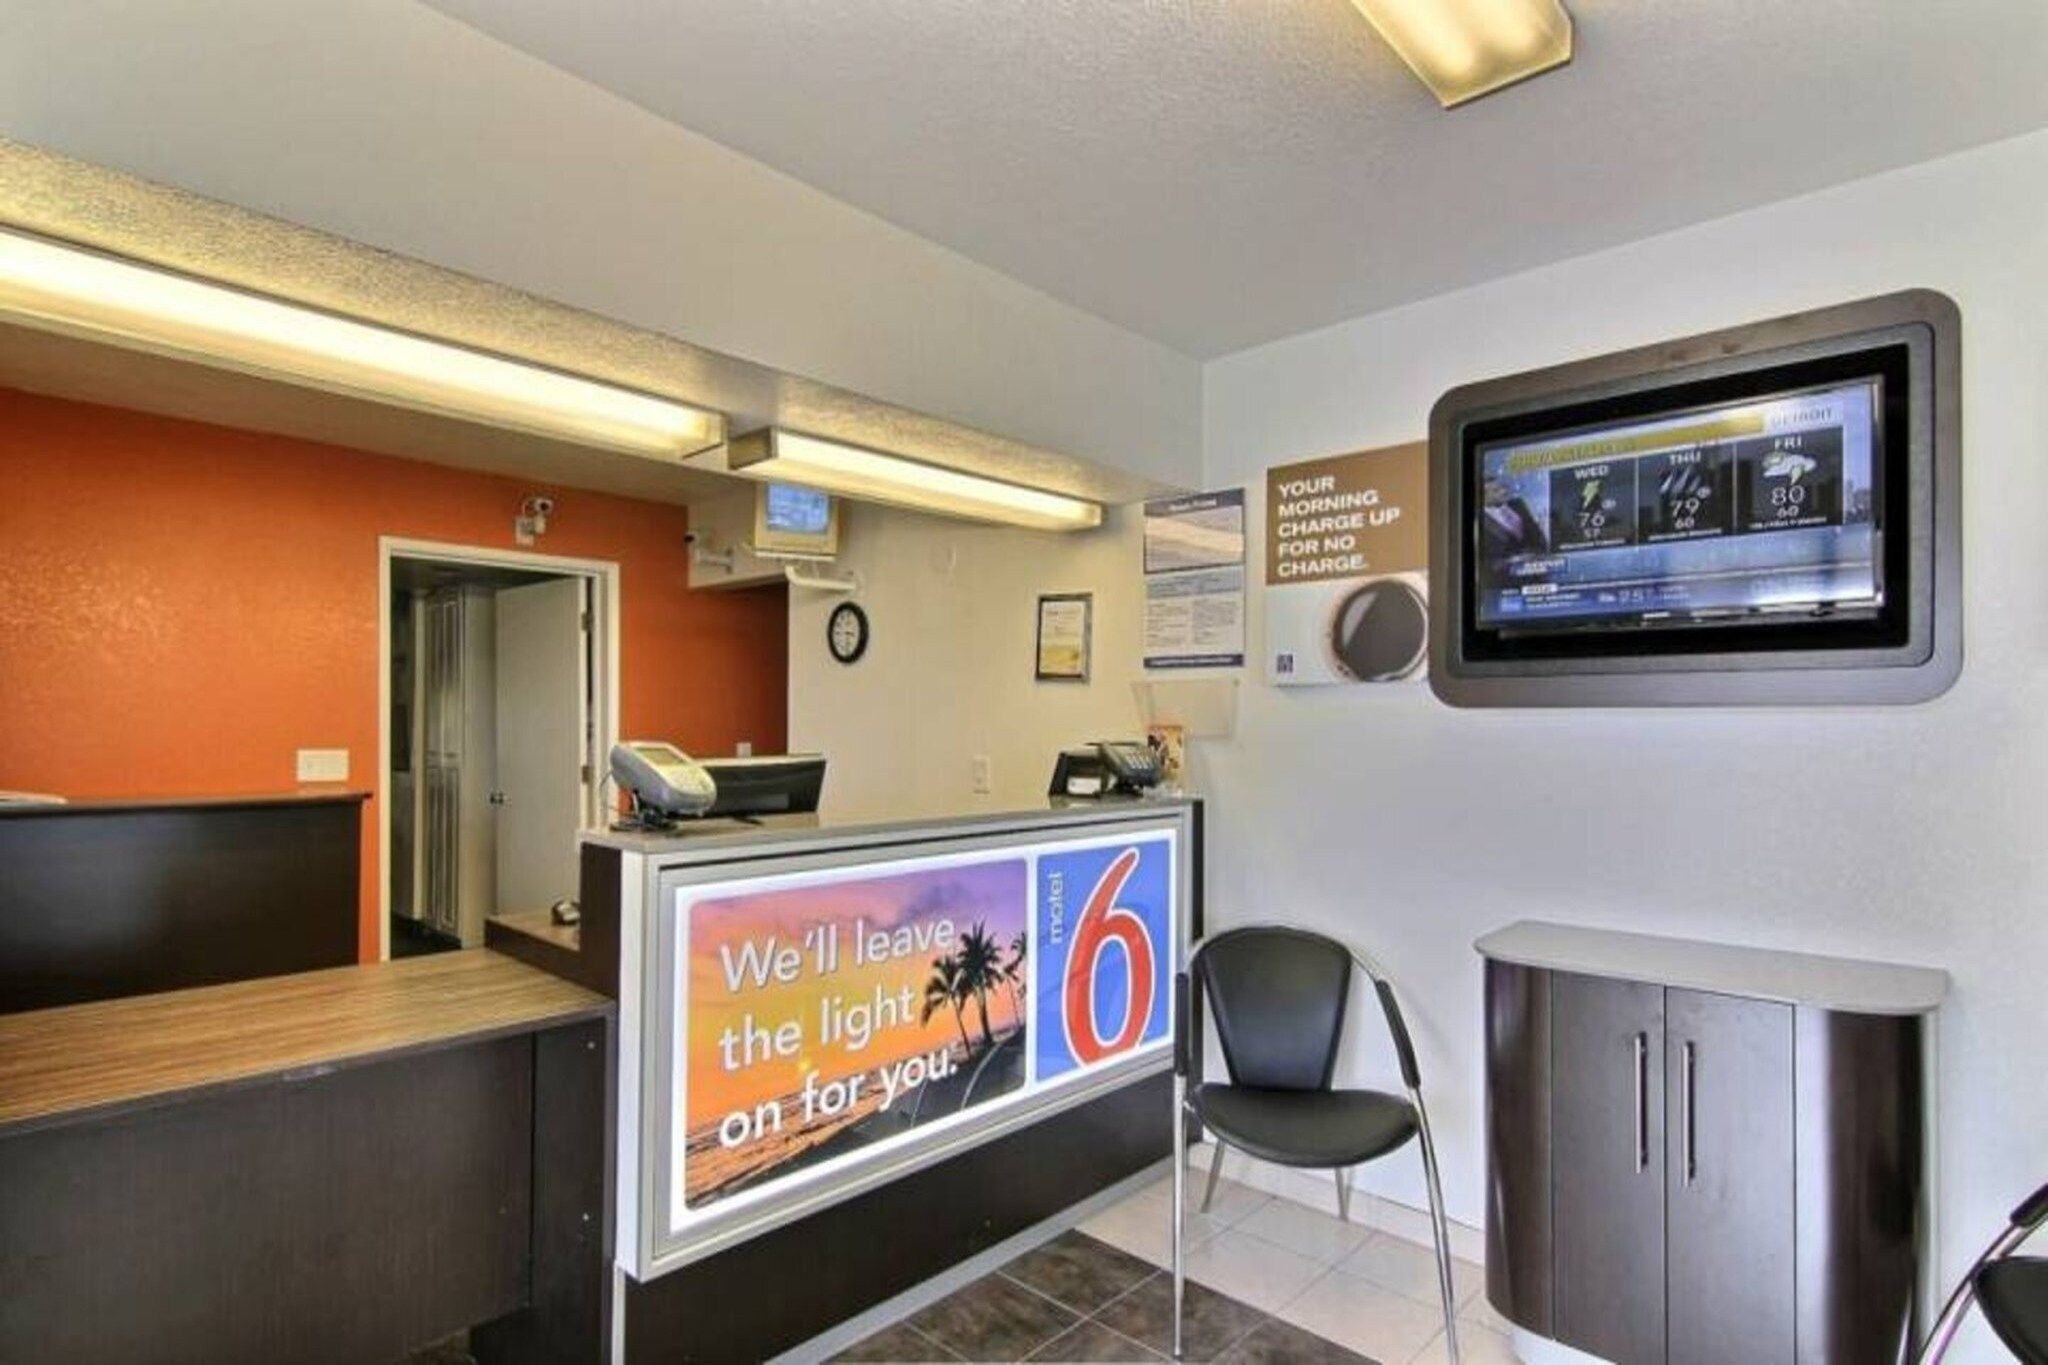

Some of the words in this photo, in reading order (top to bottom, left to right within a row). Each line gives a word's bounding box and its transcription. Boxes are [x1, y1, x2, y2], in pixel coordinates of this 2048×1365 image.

[1774, 435, 1802, 449] FRI
[1669, 451, 1701, 466] THU
[1574, 465, 1610, 480] WED
[1279, 475, 1335, 498] YOUR
[1771, 485, 1805, 506] 80
[1278, 490, 1379, 517] MORNING
[1670, 498, 1700, 517] 79
[1278, 511, 1364, 538] CHARGE
[1370, 507, 1400, 526] UP
[1578, 511, 1606, 528] 76
[1674, 517, 1695, 529] 60
[1278, 538, 1319, 557] FOR
[1324, 535, 1355, 551] NO
[1277, 555, 1368, 578] CHARGE.
[1048, 872, 1063, 944] motel
[720, 923, 839, 992] We'll
[855, 917, 955, 966] leave
[1062, 847, 1155, 1067] 6
[718, 1014, 802, 1072] the
[820, 986, 915, 1051] light
[718, 1102, 783, 1148] on
[801, 1071, 866, 1124] for
[879, 1048, 957, 1109] you.
